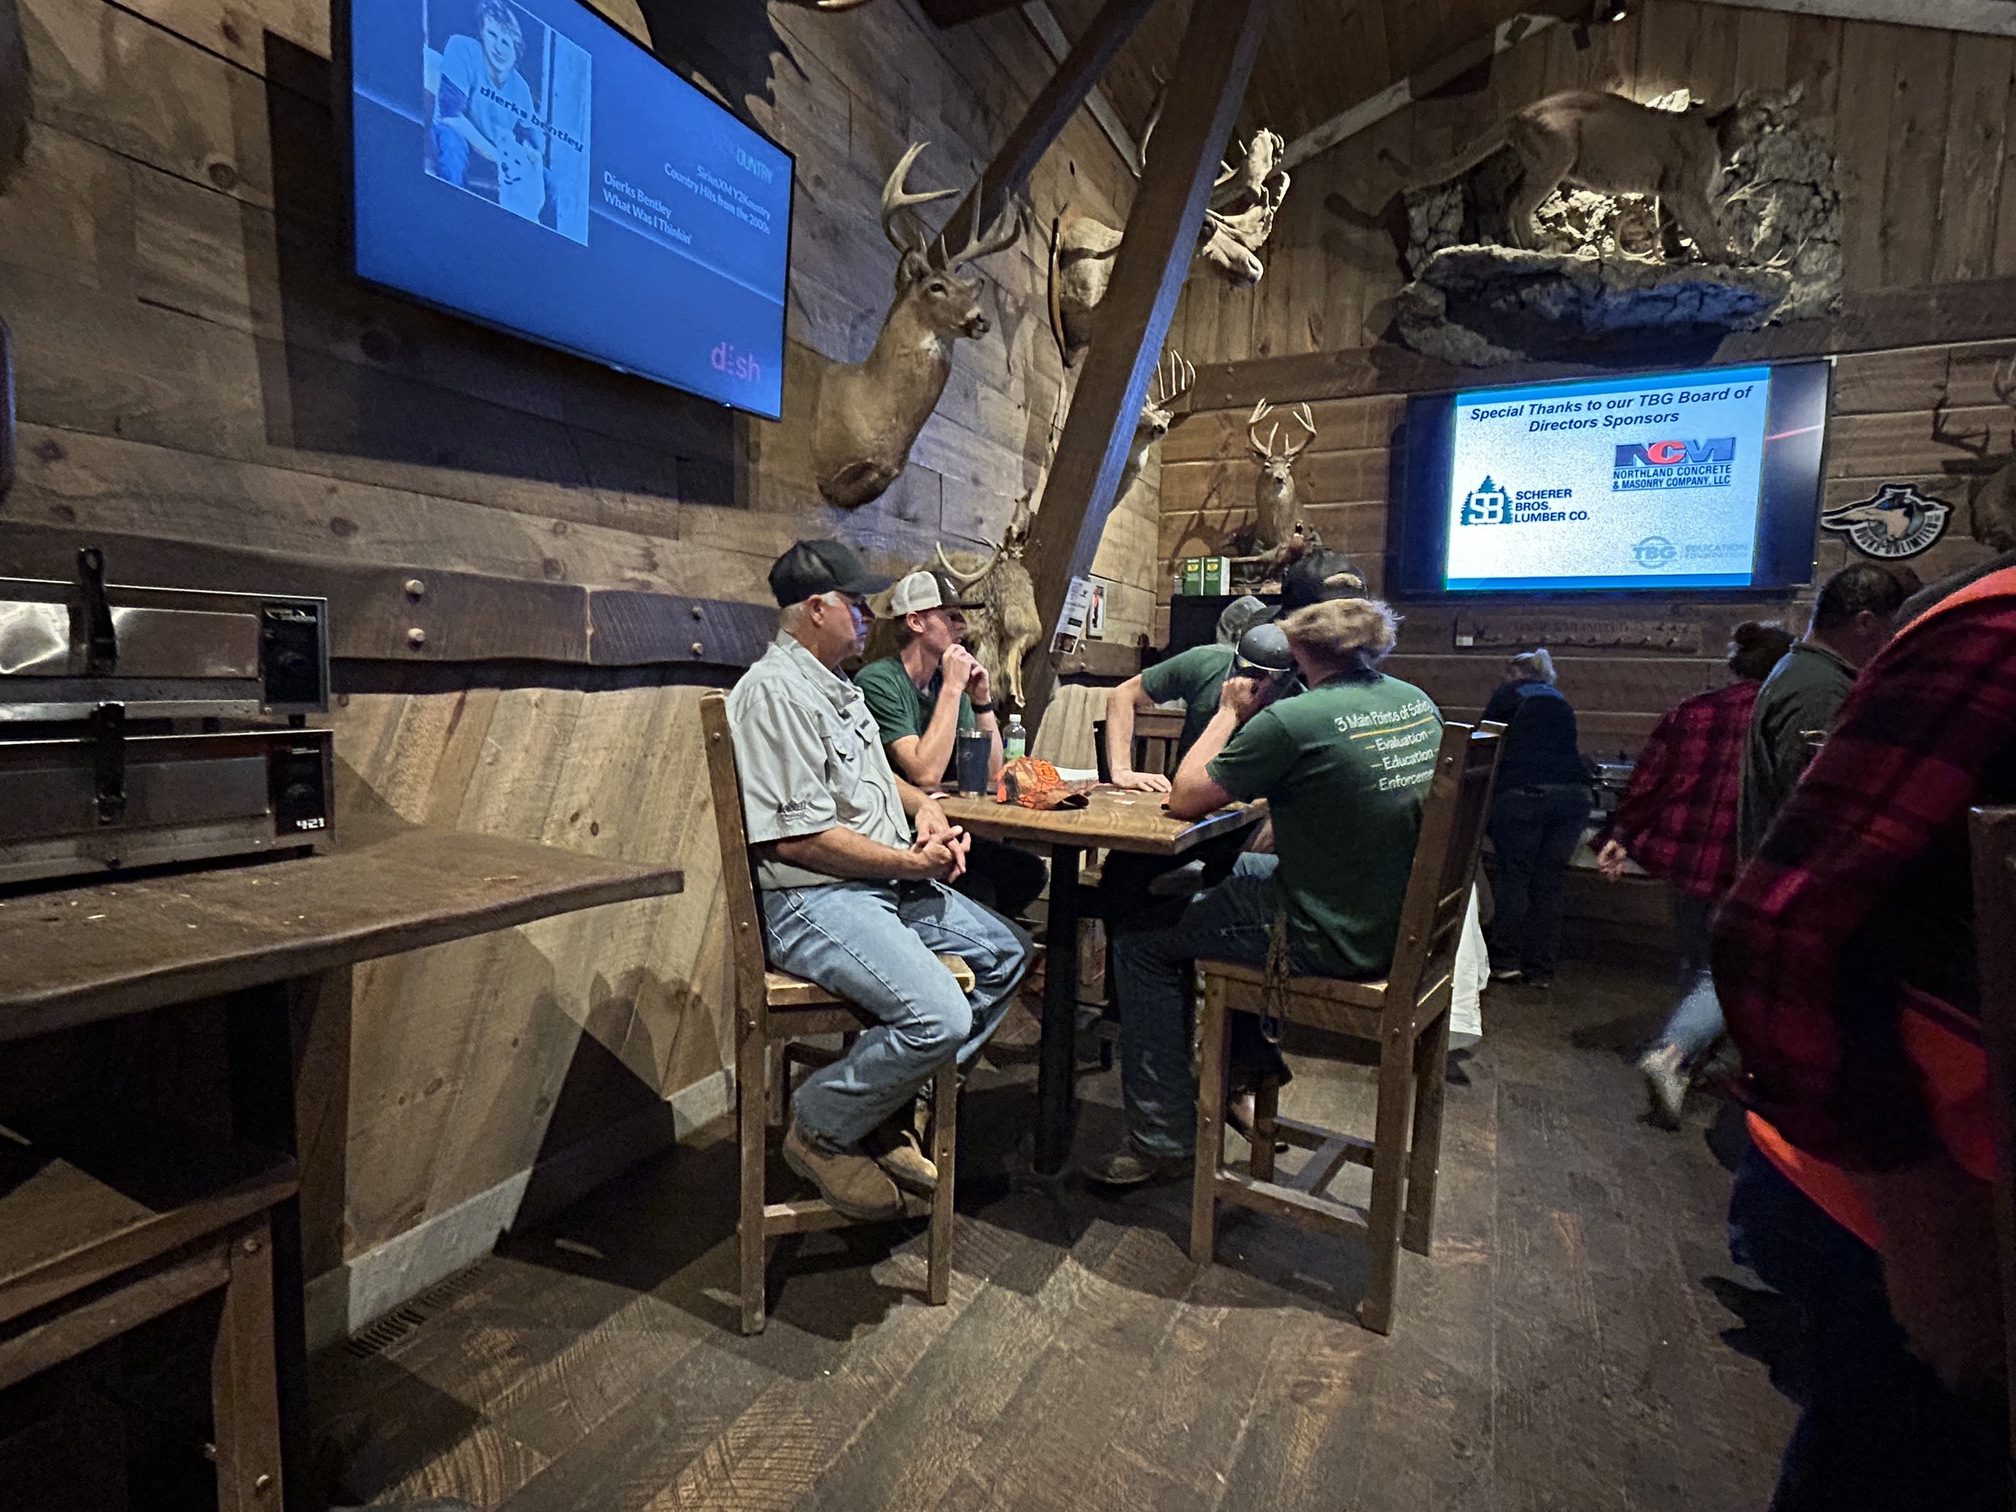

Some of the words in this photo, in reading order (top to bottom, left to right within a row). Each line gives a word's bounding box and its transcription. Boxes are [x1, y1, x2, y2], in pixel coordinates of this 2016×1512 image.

[480, 86, 528, 119] dierks
[530, 114, 584, 153] bentley
[604, 170, 636, 199] Dierks
[637, 188, 672, 219] Bentley
[664, 162, 699, 194] Country
[699, 183, 717, 203] Hits
[717, 194, 736, 215] from
[736, 206, 749, 223] the
[749, 214, 771, 235] 2000s
[603, 188, 632, 215] What
[632, 203, 653, 225] Was
[711, 342, 760, 381] dish
[1470, 404, 1525, 422] Special
[1528, 401, 1582, 417] Thanks
[1586, 398, 1603, 411] to
[1606, 397, 1634, 409] our
[1639, 392, 1674, 406] TBG
[1678, 387, 1730, 404] Board
[1734, 385, 1754, 399] of
[1528, 416, 1598, 433] Directors
[1602, 410, 1680, 428] Sponsors
[1614, 437, 1737, 468] NCM
[1612, 467, 1674, 480] NORTHLAND
[1676, 464, 1732, 476] CONCRETE
[1612, 480, 1620, 490] &
[1621, 478, 1664, 490] MASONRY
[1713, 474, 1731, 485] LLC
[1515, 488, 1573, 501] SCHERER
[1514, 511, 1567, 523] LUMBER
[1569, 510, 1591, 521] CO.
[1515, 501, 1552, 512] BROS.
[1885, 522, 1939, 555] UNLIMITED
[1632, 545, 1679, 560] TBG
[1334, 716, 1348, 732] 3
[1346, 713, 1373, 729] Main
[1370, 711, 1401, 726] Points
[1400, 704, 1410, 720] of
[1375, 730, 1428, 751] Evaluation
[1382, 748, 1434, 770] Education
[296, 817, 325, 830] 421
